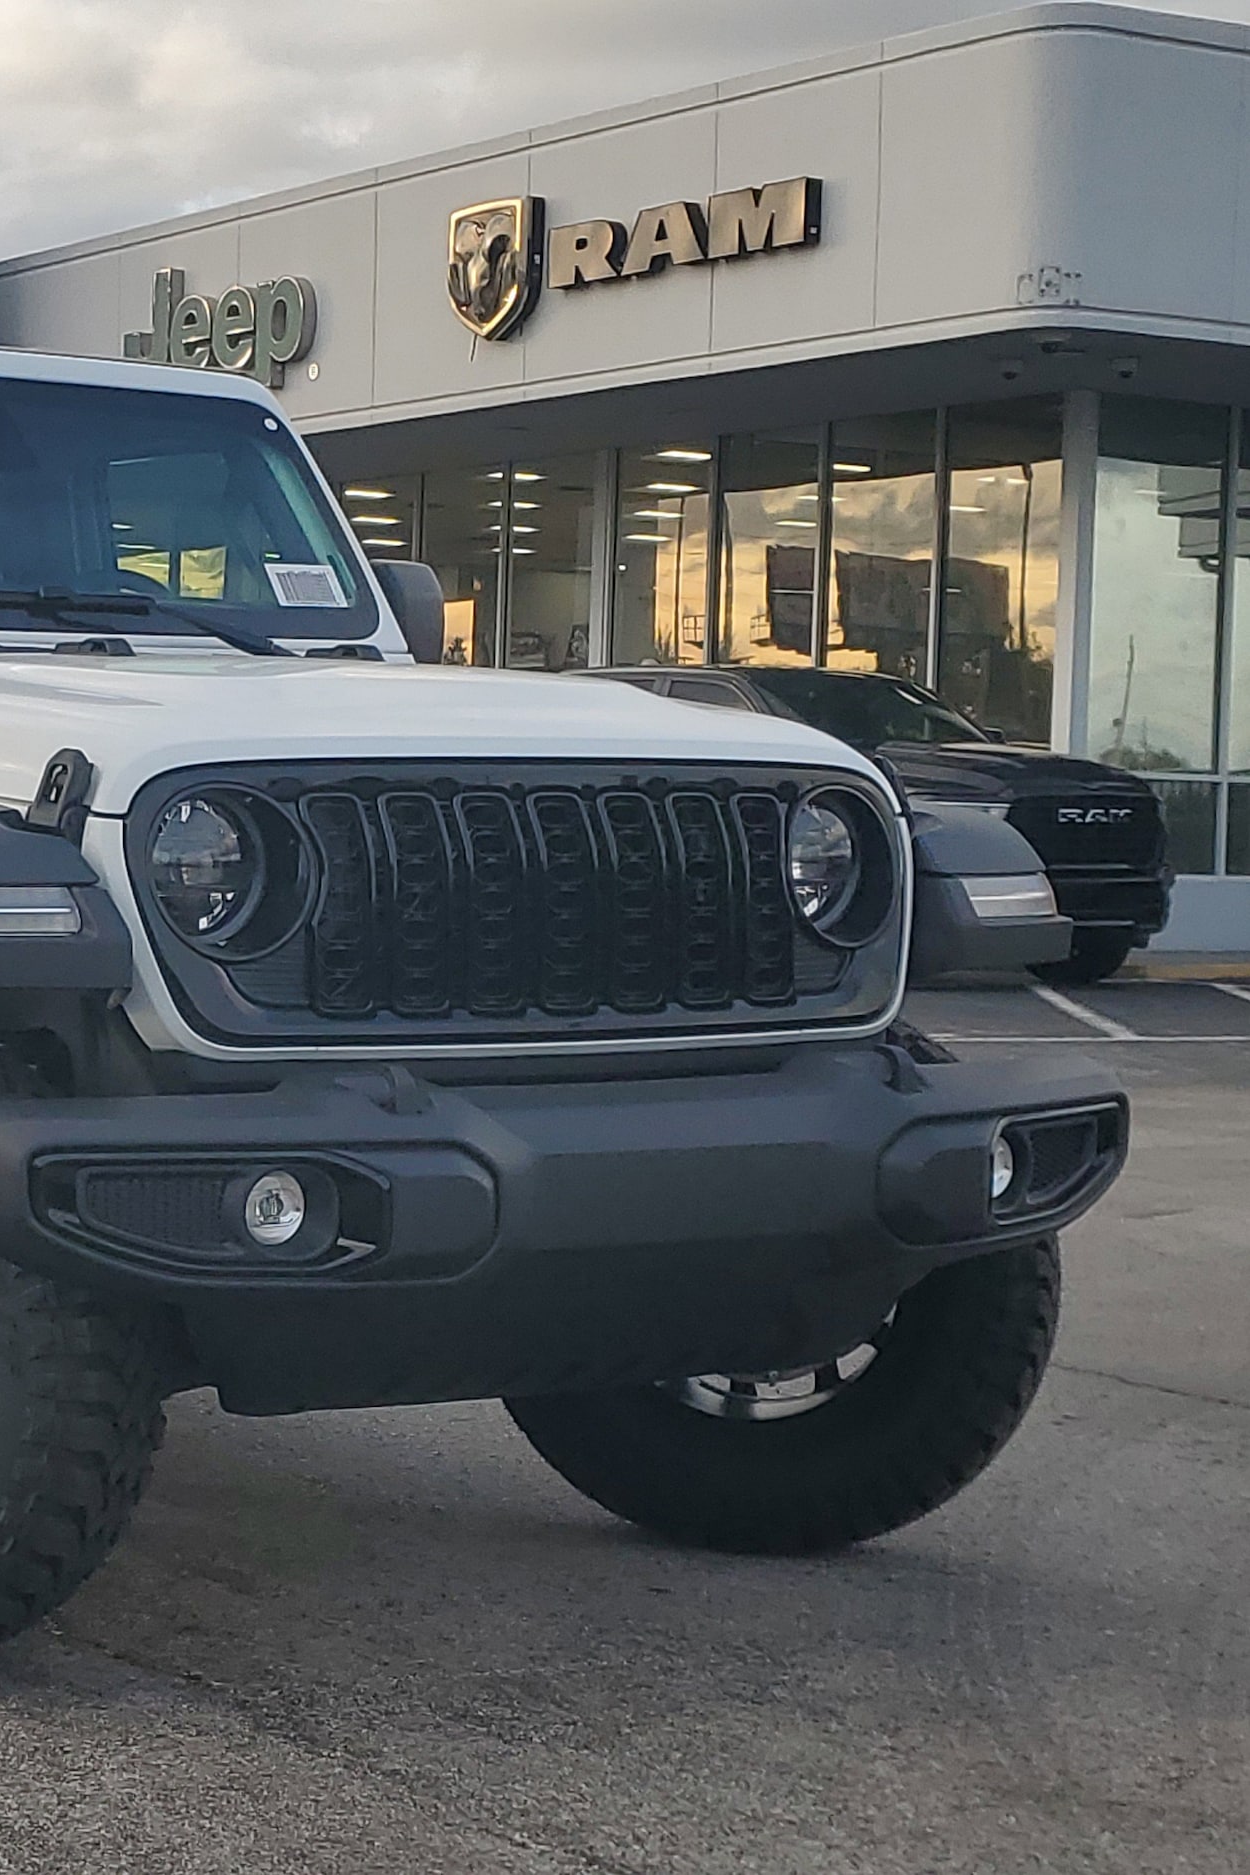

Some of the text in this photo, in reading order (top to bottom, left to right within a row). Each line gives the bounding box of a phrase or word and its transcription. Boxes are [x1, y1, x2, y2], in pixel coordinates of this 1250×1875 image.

[548, 176, 823, 290] RAM
[123, 267, 317, 389] Jeep
[1058, 808, 1134, 823] RAM
